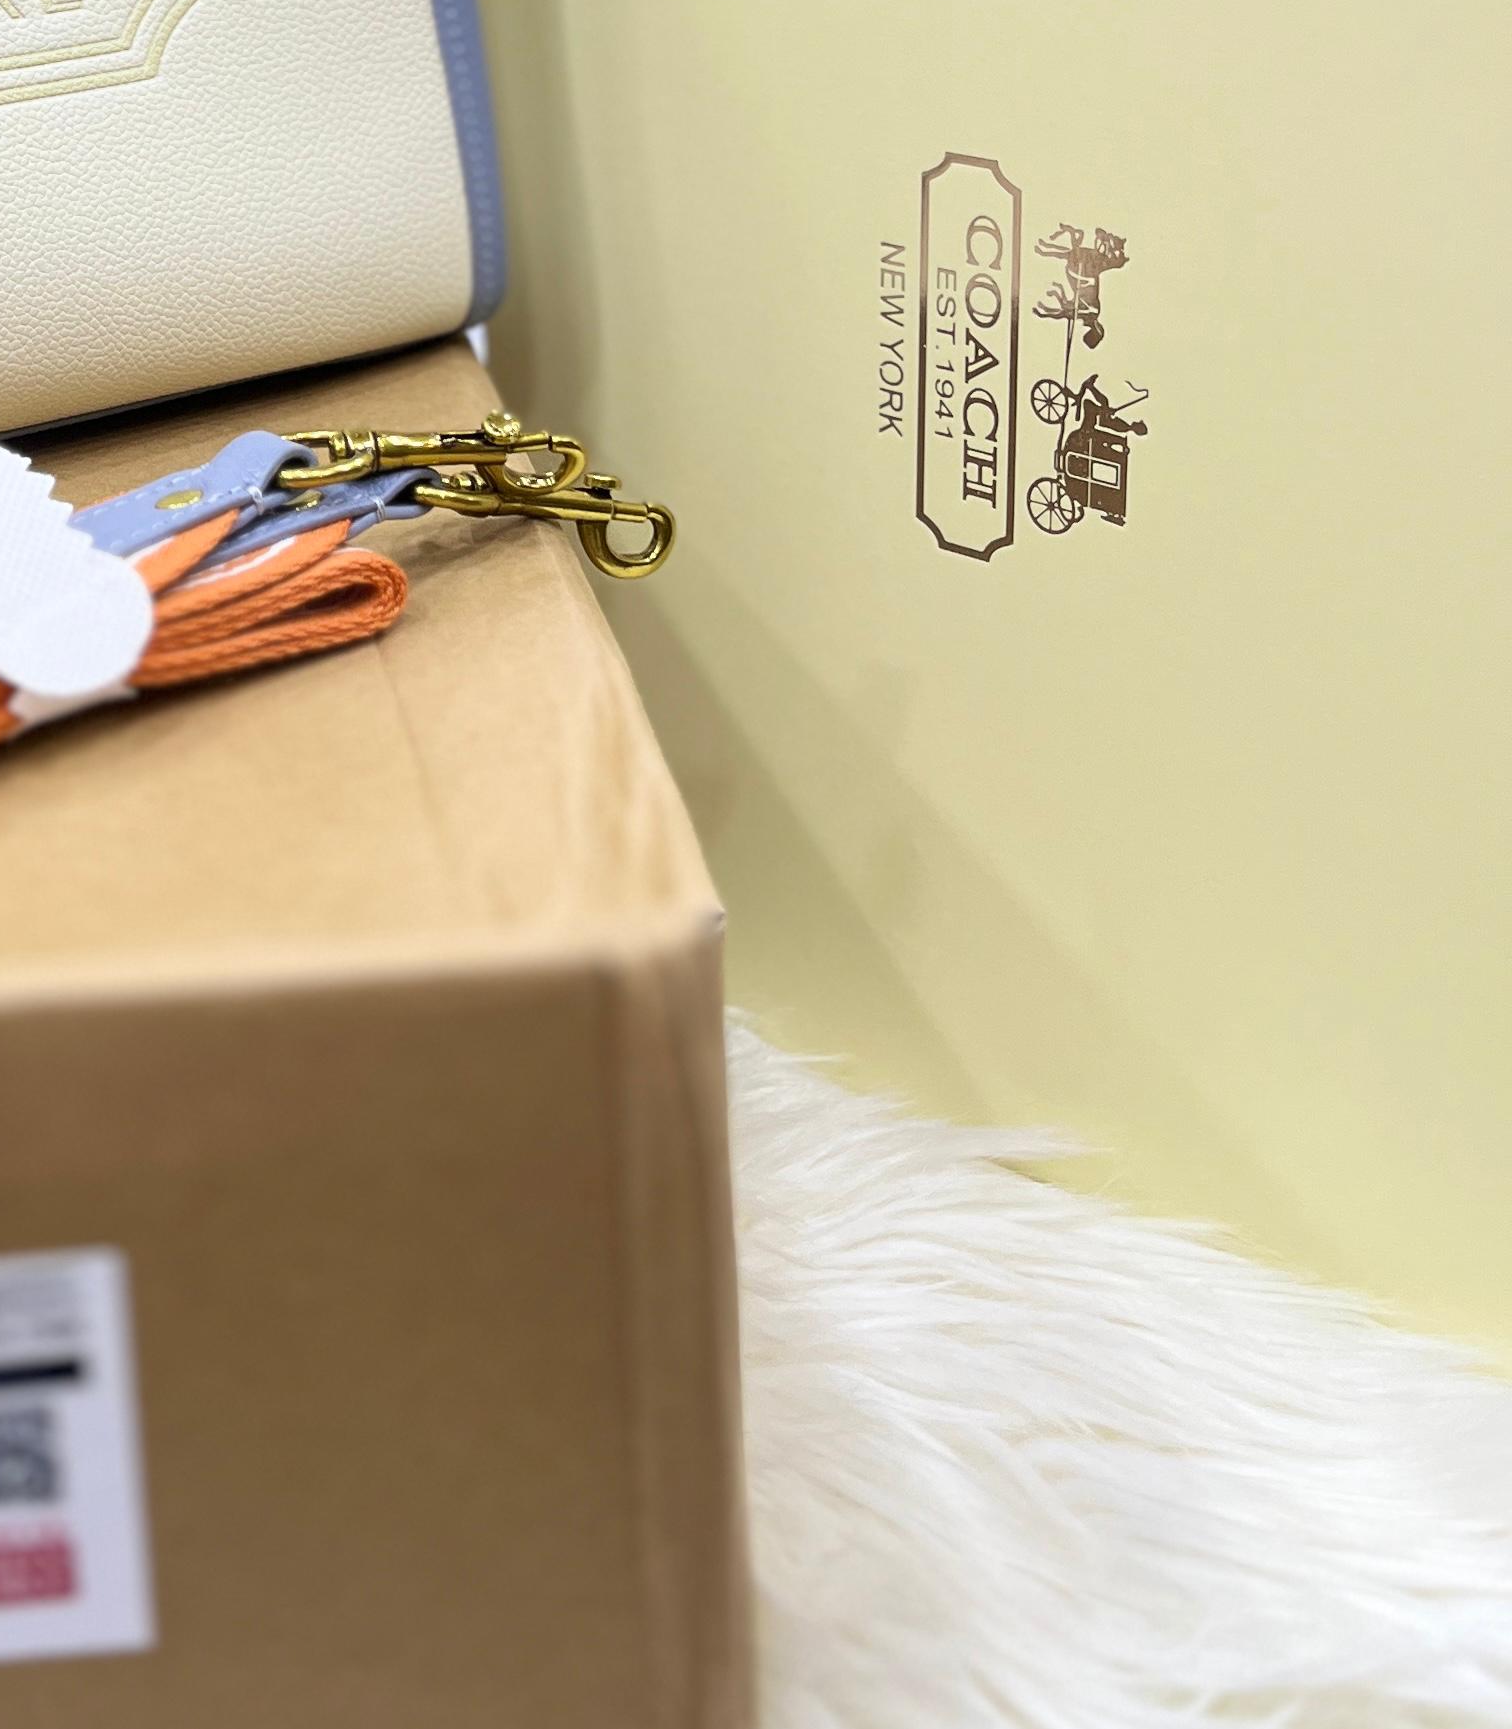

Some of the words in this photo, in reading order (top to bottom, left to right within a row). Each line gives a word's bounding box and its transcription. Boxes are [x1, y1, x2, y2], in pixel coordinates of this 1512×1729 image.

[880, 242, 906, 329] NEW
[934, 267, 957, 350] EST.
[878, 338, 905, 438] YORK
[934, 359, 955, 440] 1941
[962, 215, 1003, 509] COACH
